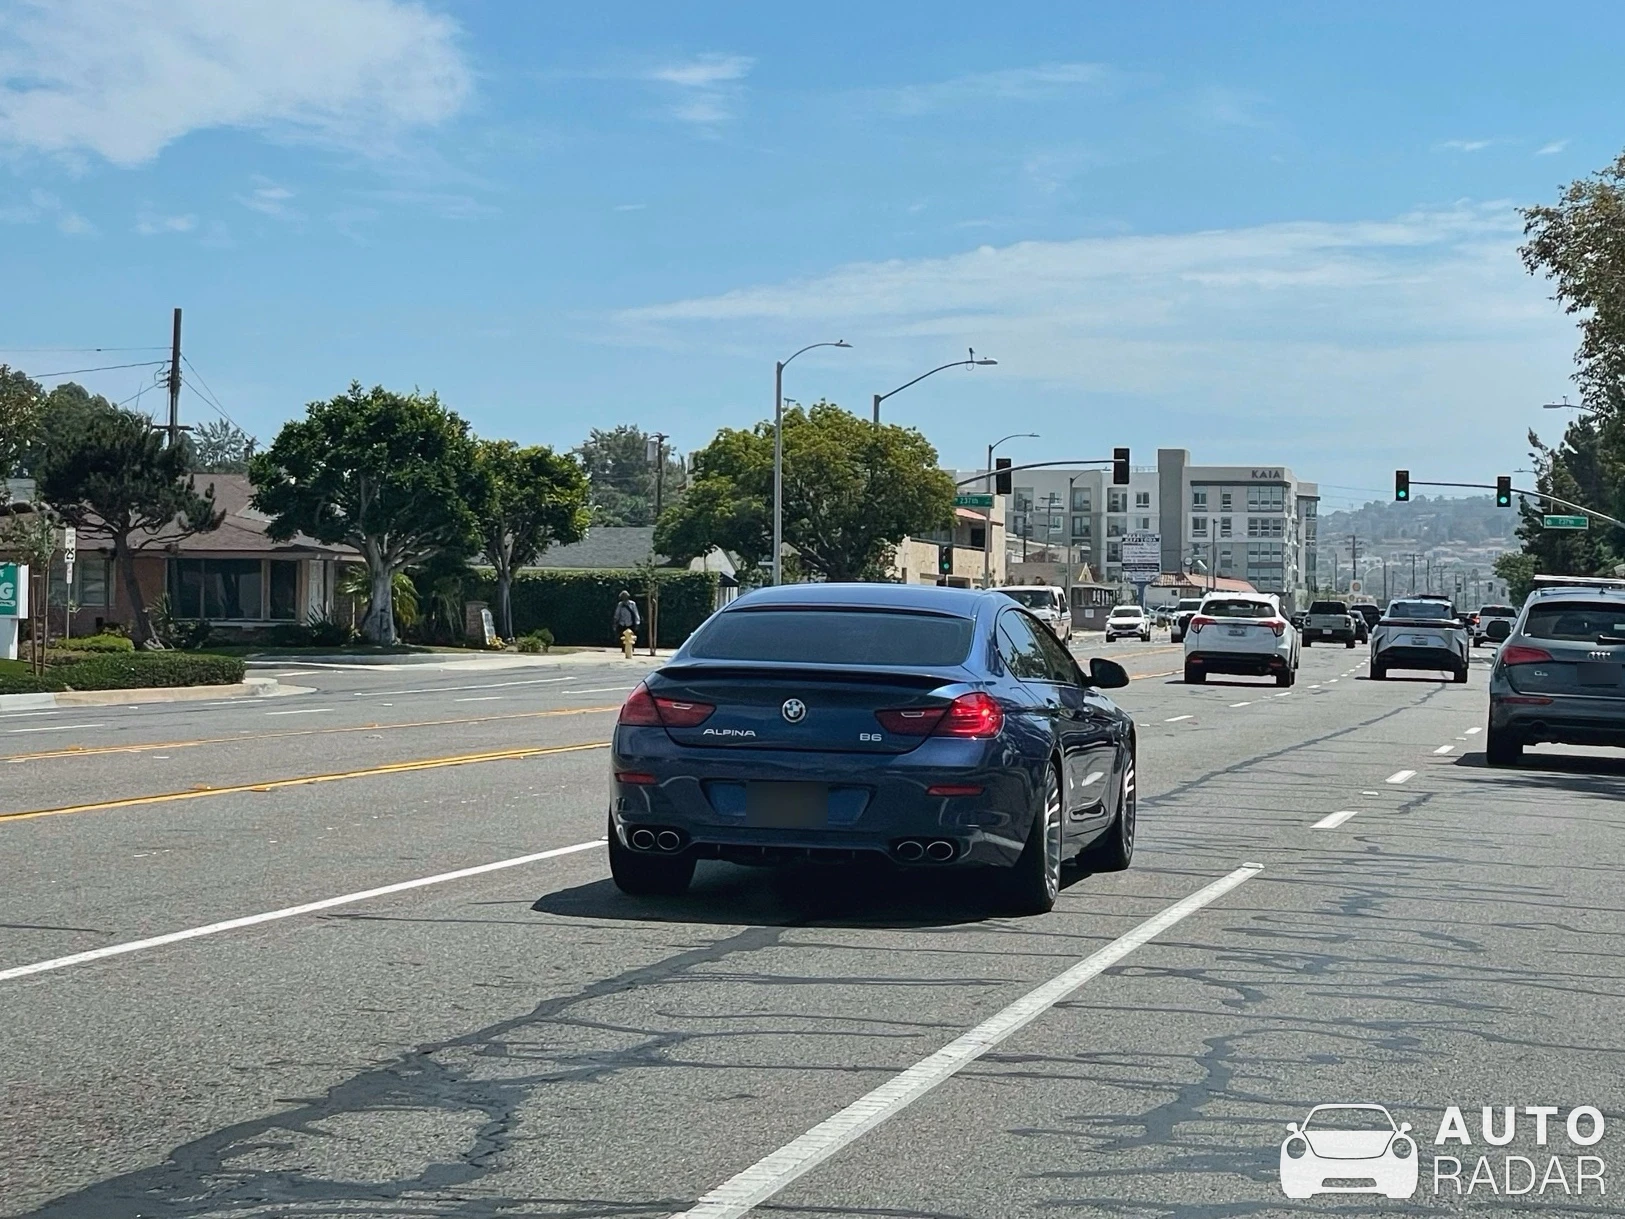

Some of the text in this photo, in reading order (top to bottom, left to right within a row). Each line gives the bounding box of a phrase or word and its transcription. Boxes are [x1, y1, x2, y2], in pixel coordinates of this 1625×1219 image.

[1251, 469, 1281, 479] KAIA
[702, 728, 757, 738] ALPINA
[859, 732, 883, 742] B6
